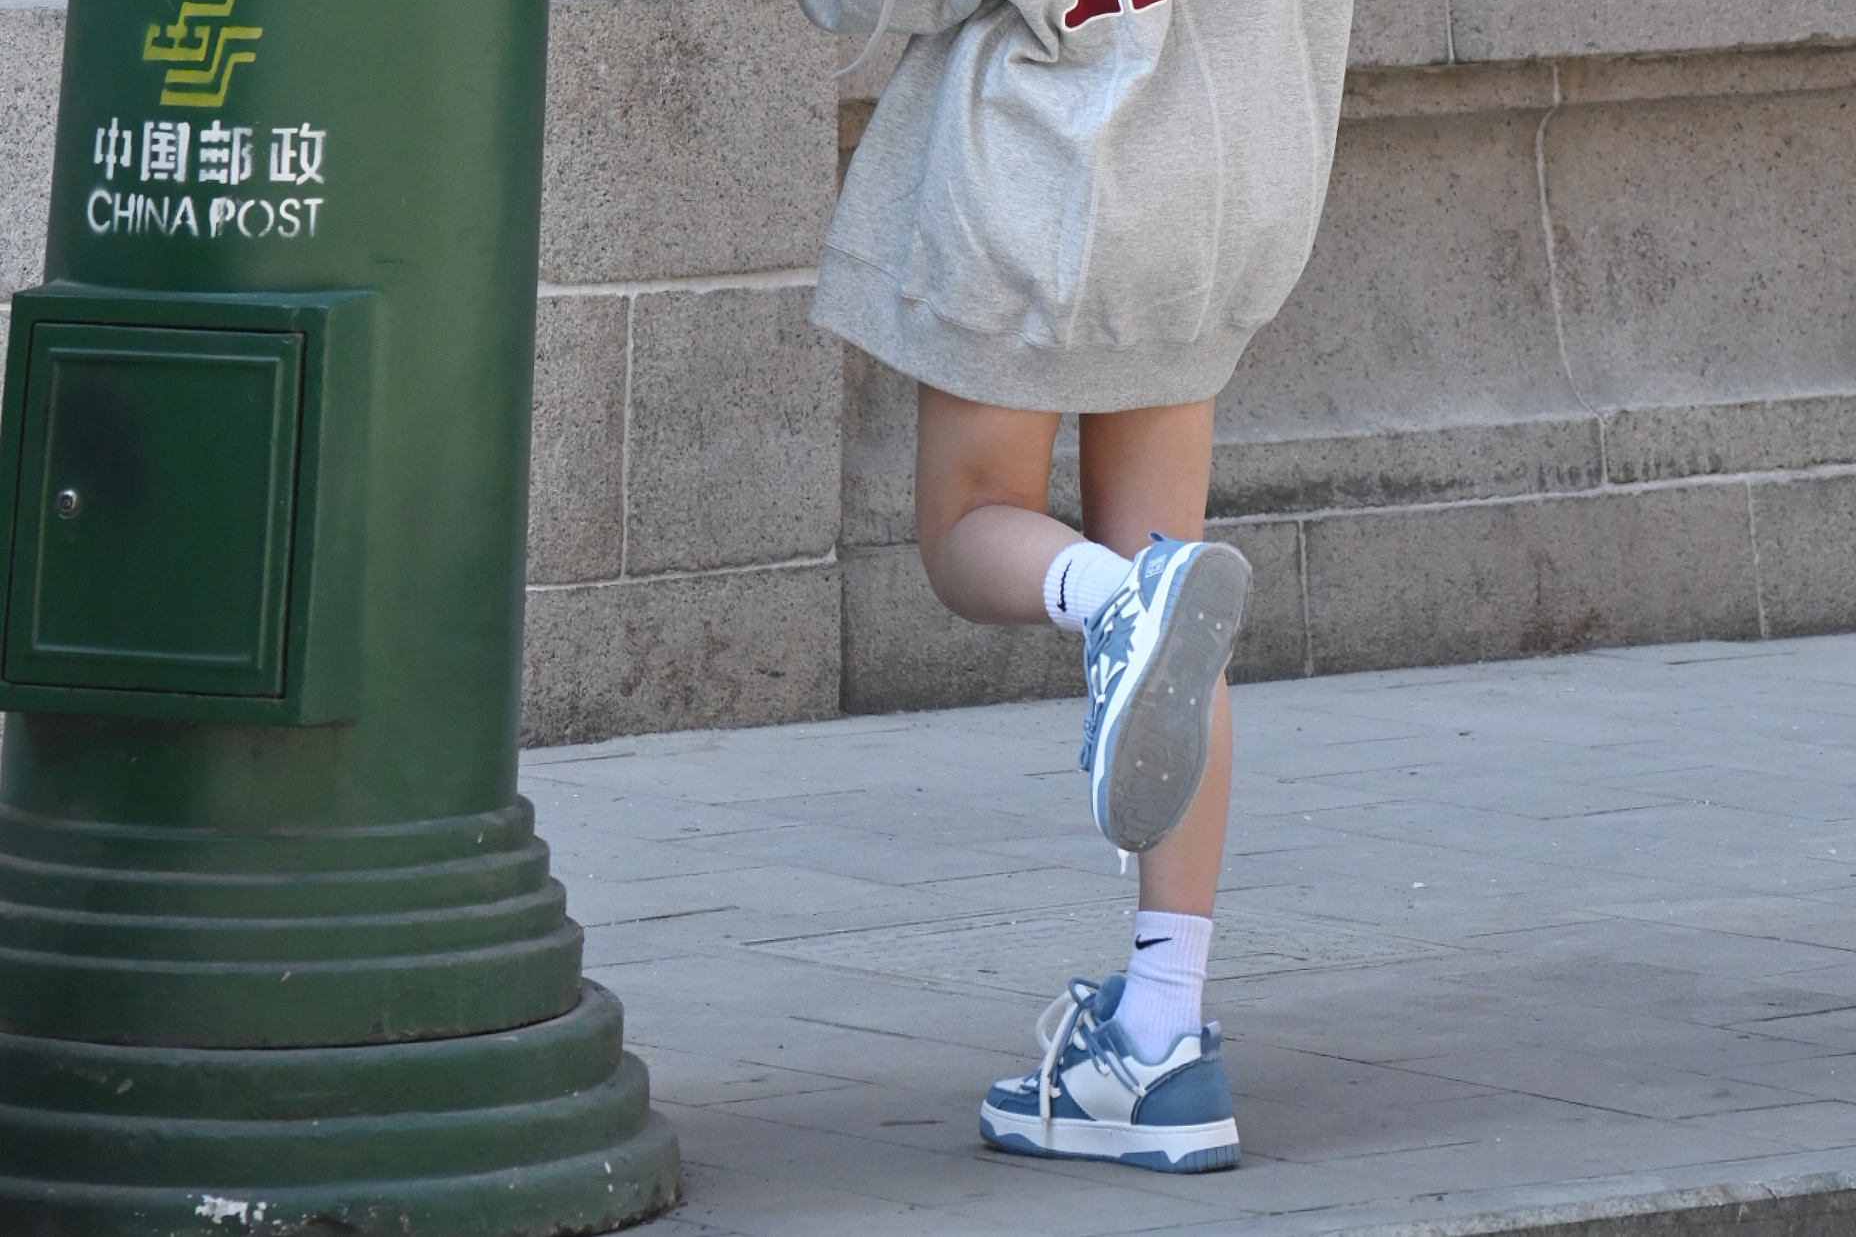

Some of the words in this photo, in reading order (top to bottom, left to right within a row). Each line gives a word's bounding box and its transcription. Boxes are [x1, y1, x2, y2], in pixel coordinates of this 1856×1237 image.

[93, 117, 328, 186] 中国邮政
[87, 189, 199, 238] CHINA
[209, 196, 325, 239] POST
